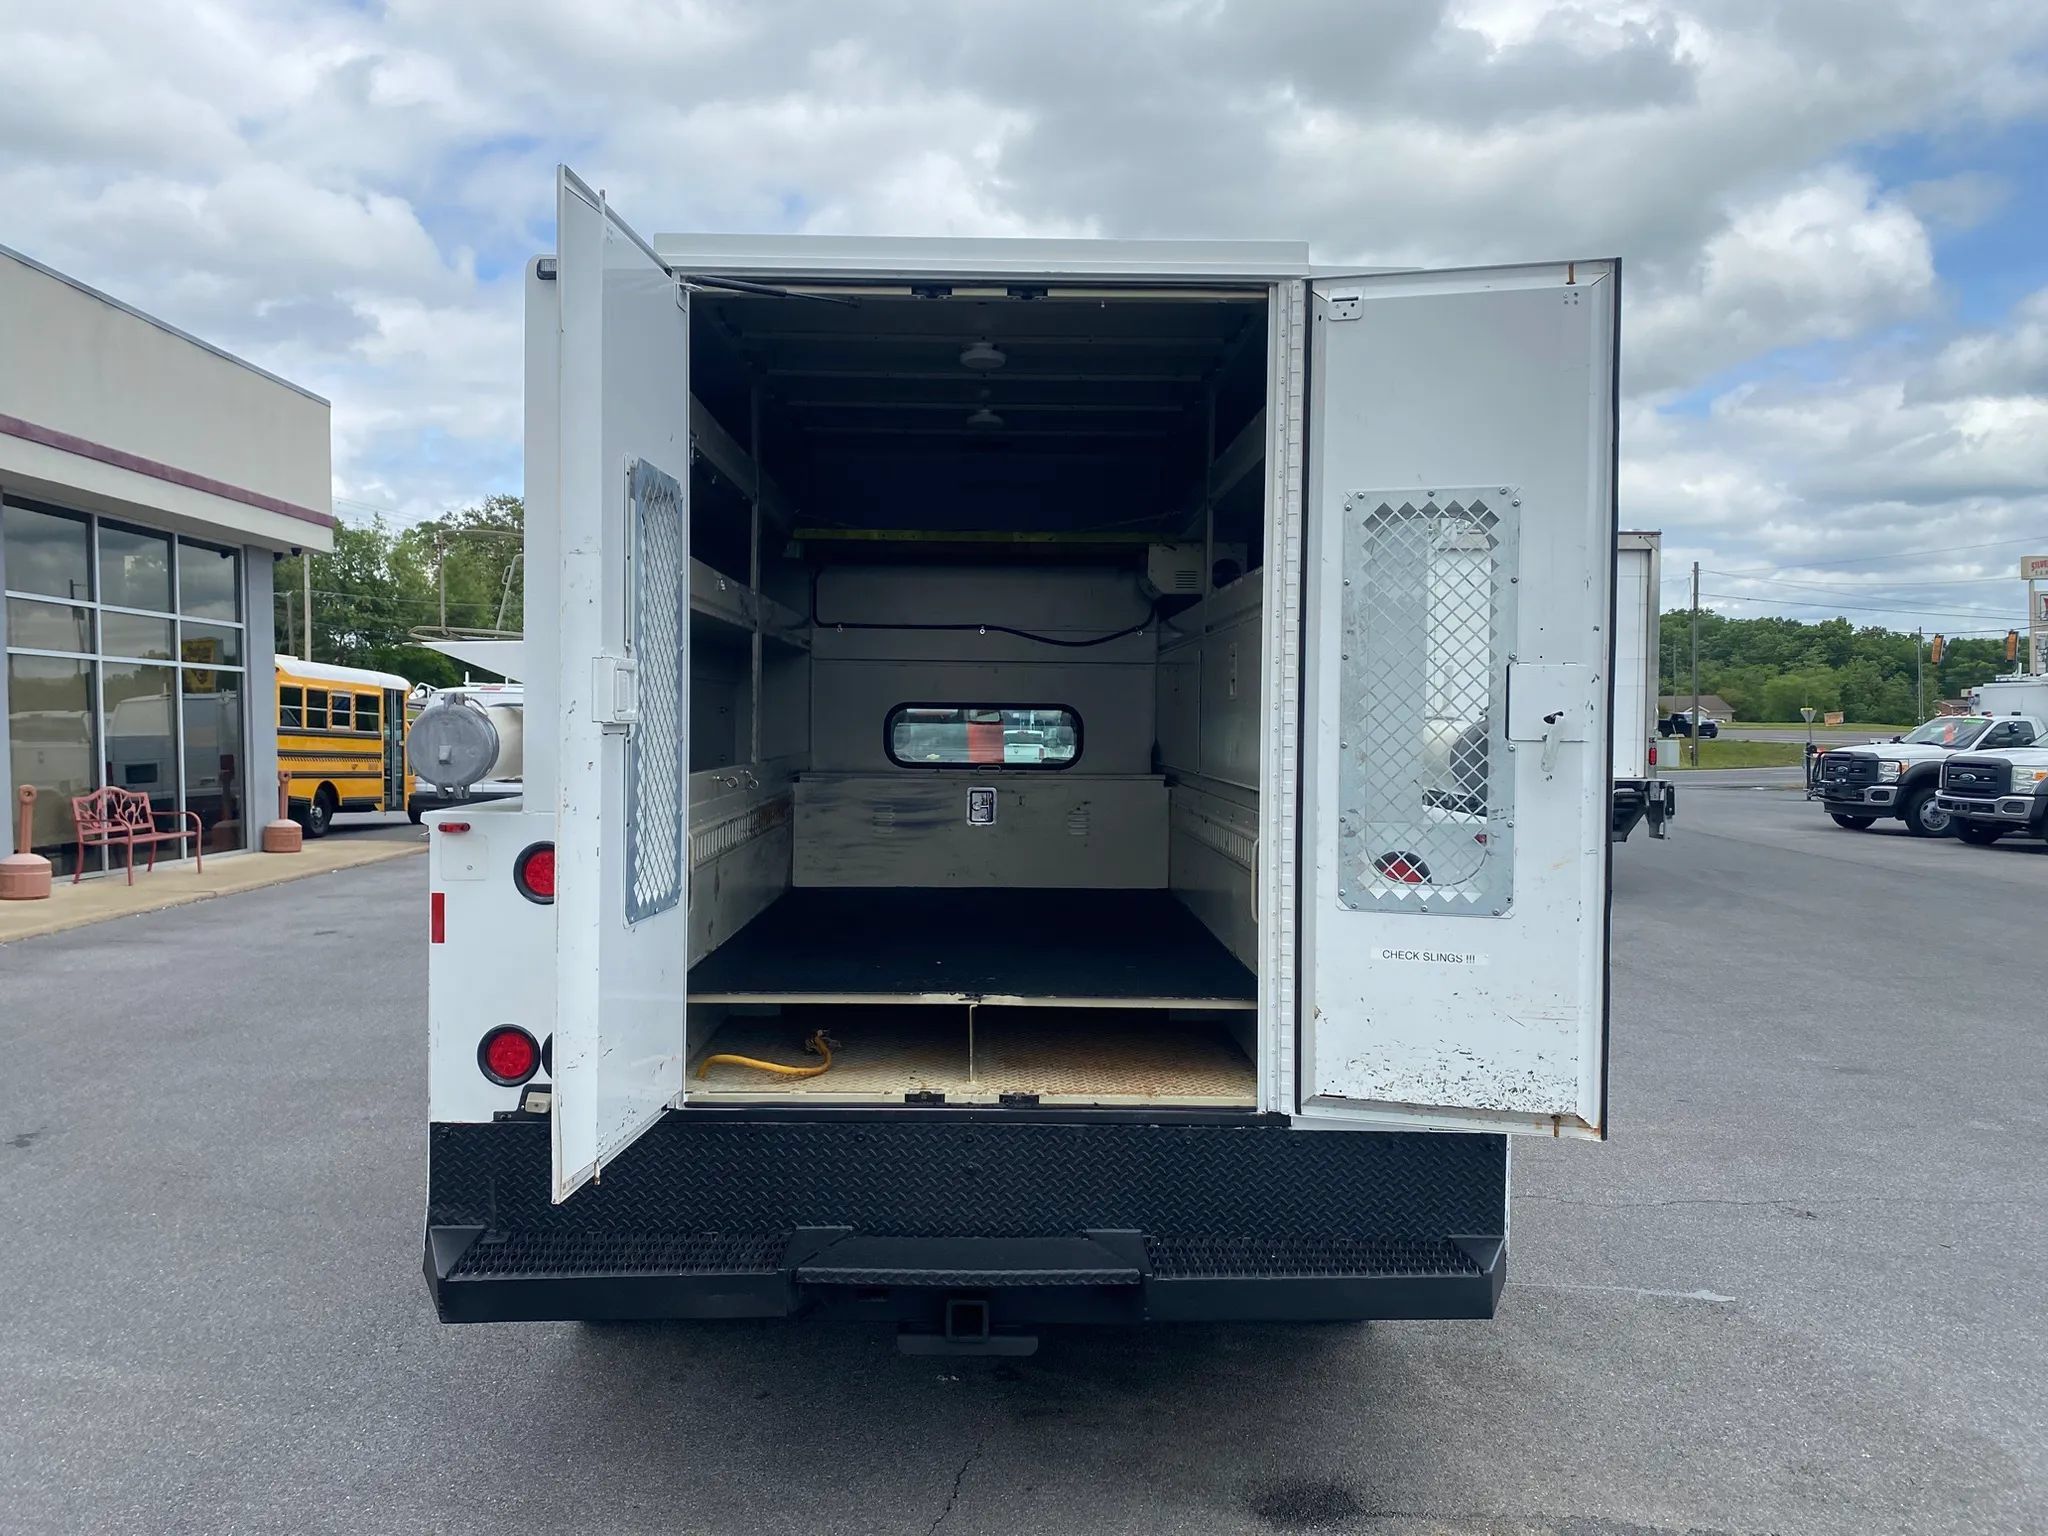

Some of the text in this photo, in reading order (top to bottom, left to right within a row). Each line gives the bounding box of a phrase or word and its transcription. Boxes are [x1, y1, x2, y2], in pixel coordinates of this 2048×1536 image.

[1382, 949, 1475, 964] CHECK SLINGS !!!
